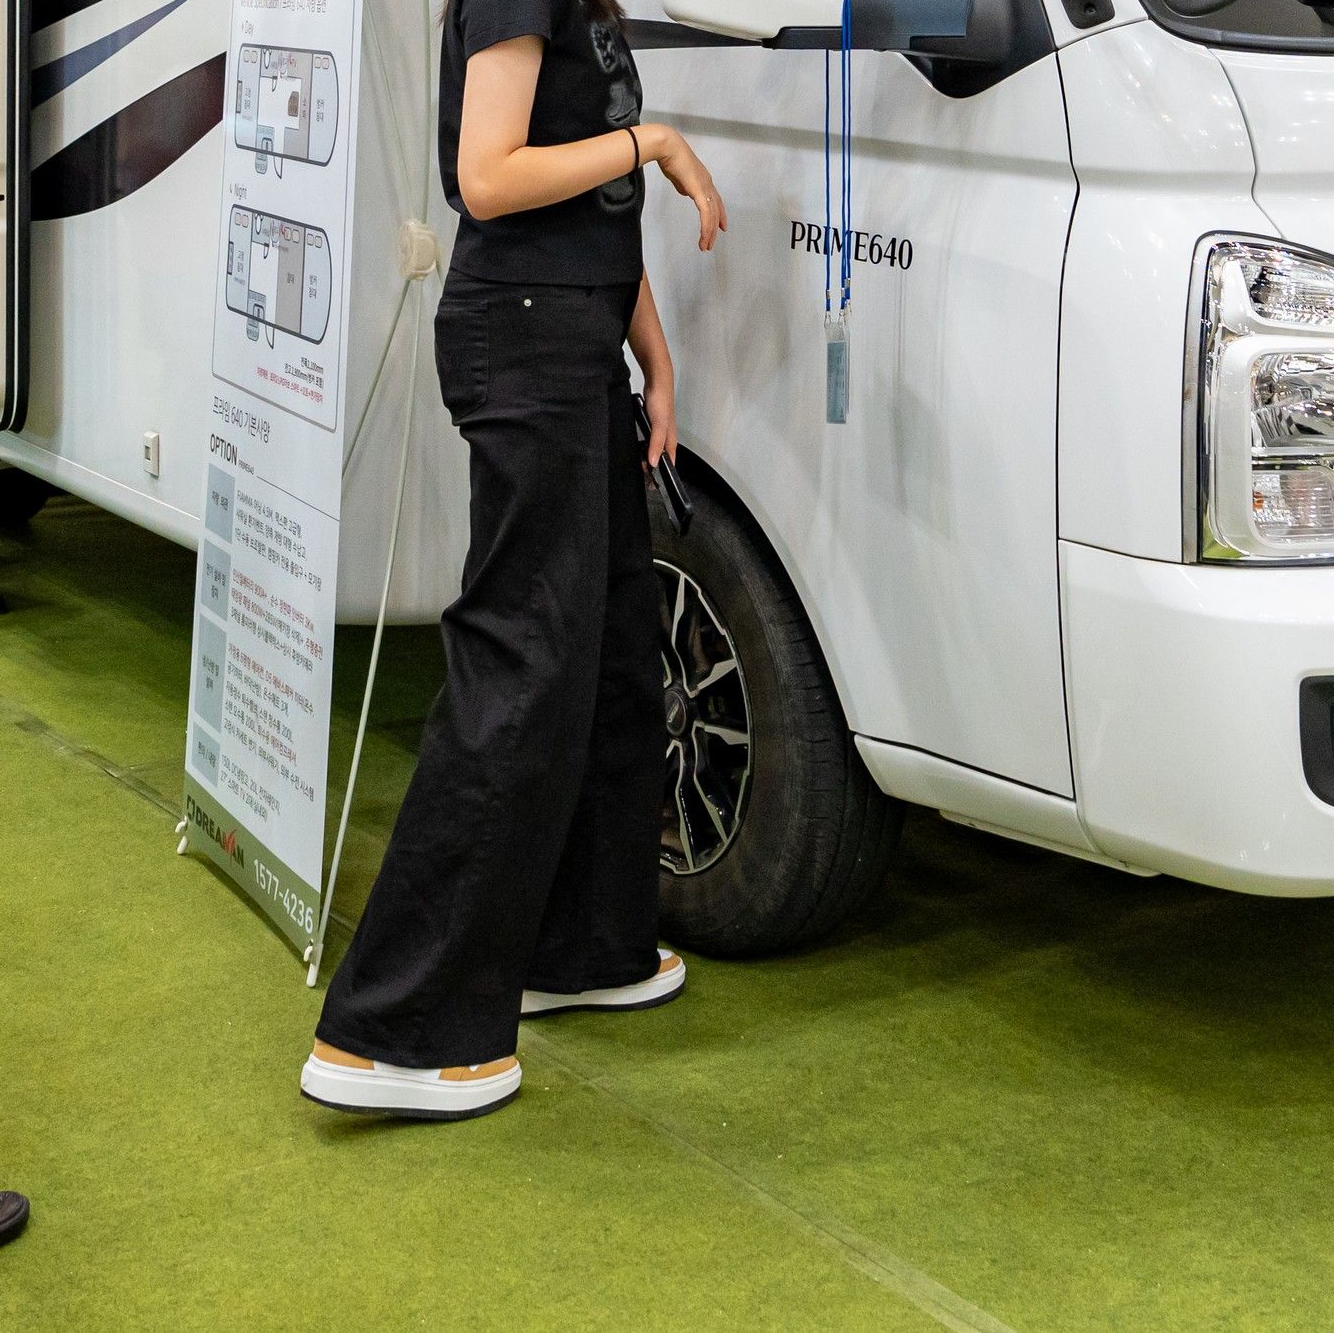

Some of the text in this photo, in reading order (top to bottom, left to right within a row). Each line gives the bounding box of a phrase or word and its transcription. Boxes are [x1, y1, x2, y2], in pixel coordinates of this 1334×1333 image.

[234, 183, 248, 199] Night
[790, 220, 913, 270] PRIME640
[213, 396, 270, 443] 프라임 640 기본사양
[210, 434, 237, 465] OPTION
[253, 859, 314, 934] 1577-4236
